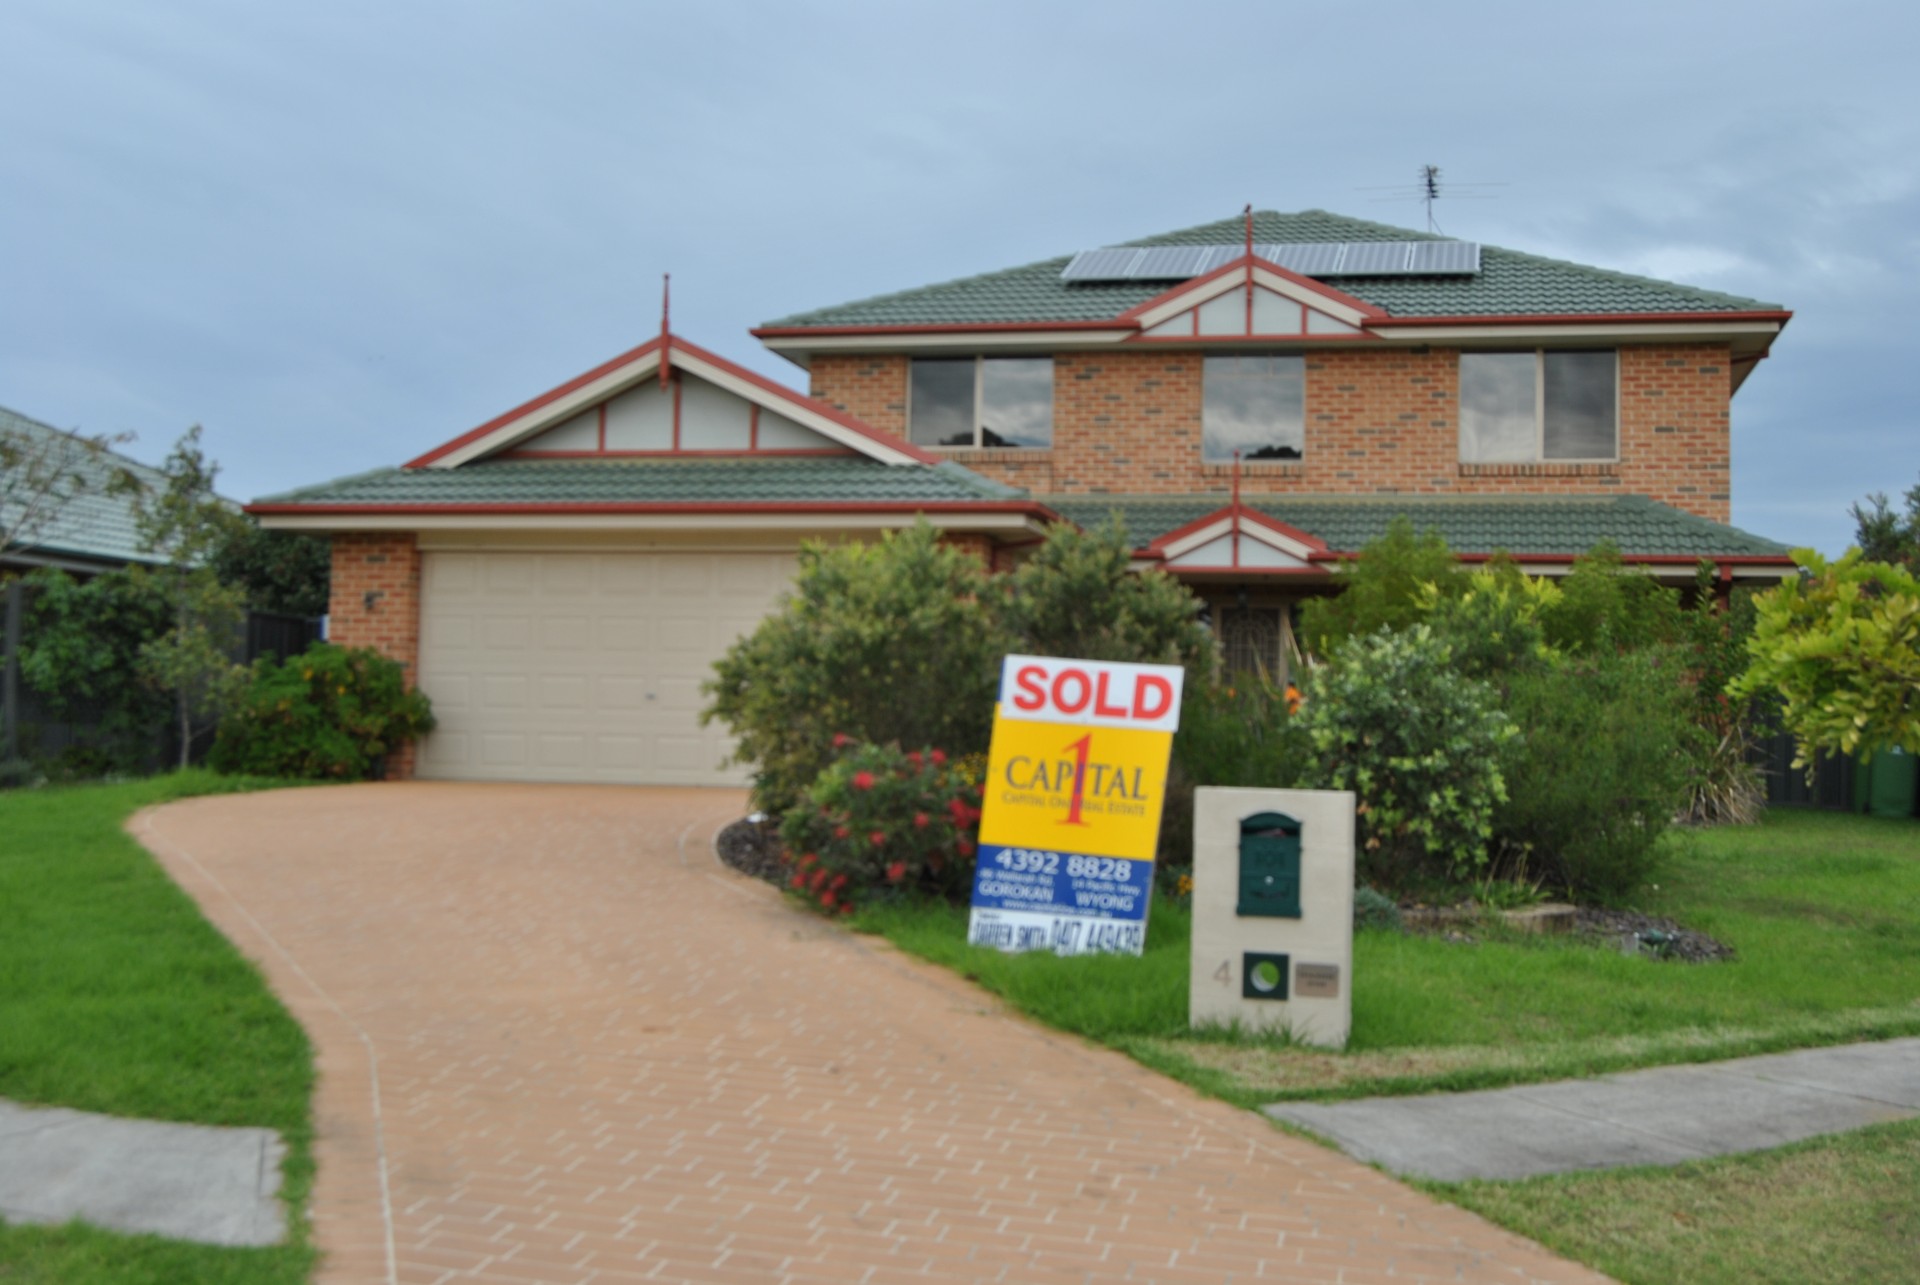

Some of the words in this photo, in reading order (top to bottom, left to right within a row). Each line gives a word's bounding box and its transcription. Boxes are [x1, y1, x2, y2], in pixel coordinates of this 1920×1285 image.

[1012, 665, 1174, 721] SOLD
[1004, 755, 1149, 802] CAPITAL
[1057, 731, 1094, 828] 1
[995, 849, 1060, 875] 4392
[1066, 855, 1132, 882] 8828
[979, 880, 1055, 902] GOROKAN
[1075, 891, 1135, 913] WYONG
[1212, 959, 1234, 989] 4
